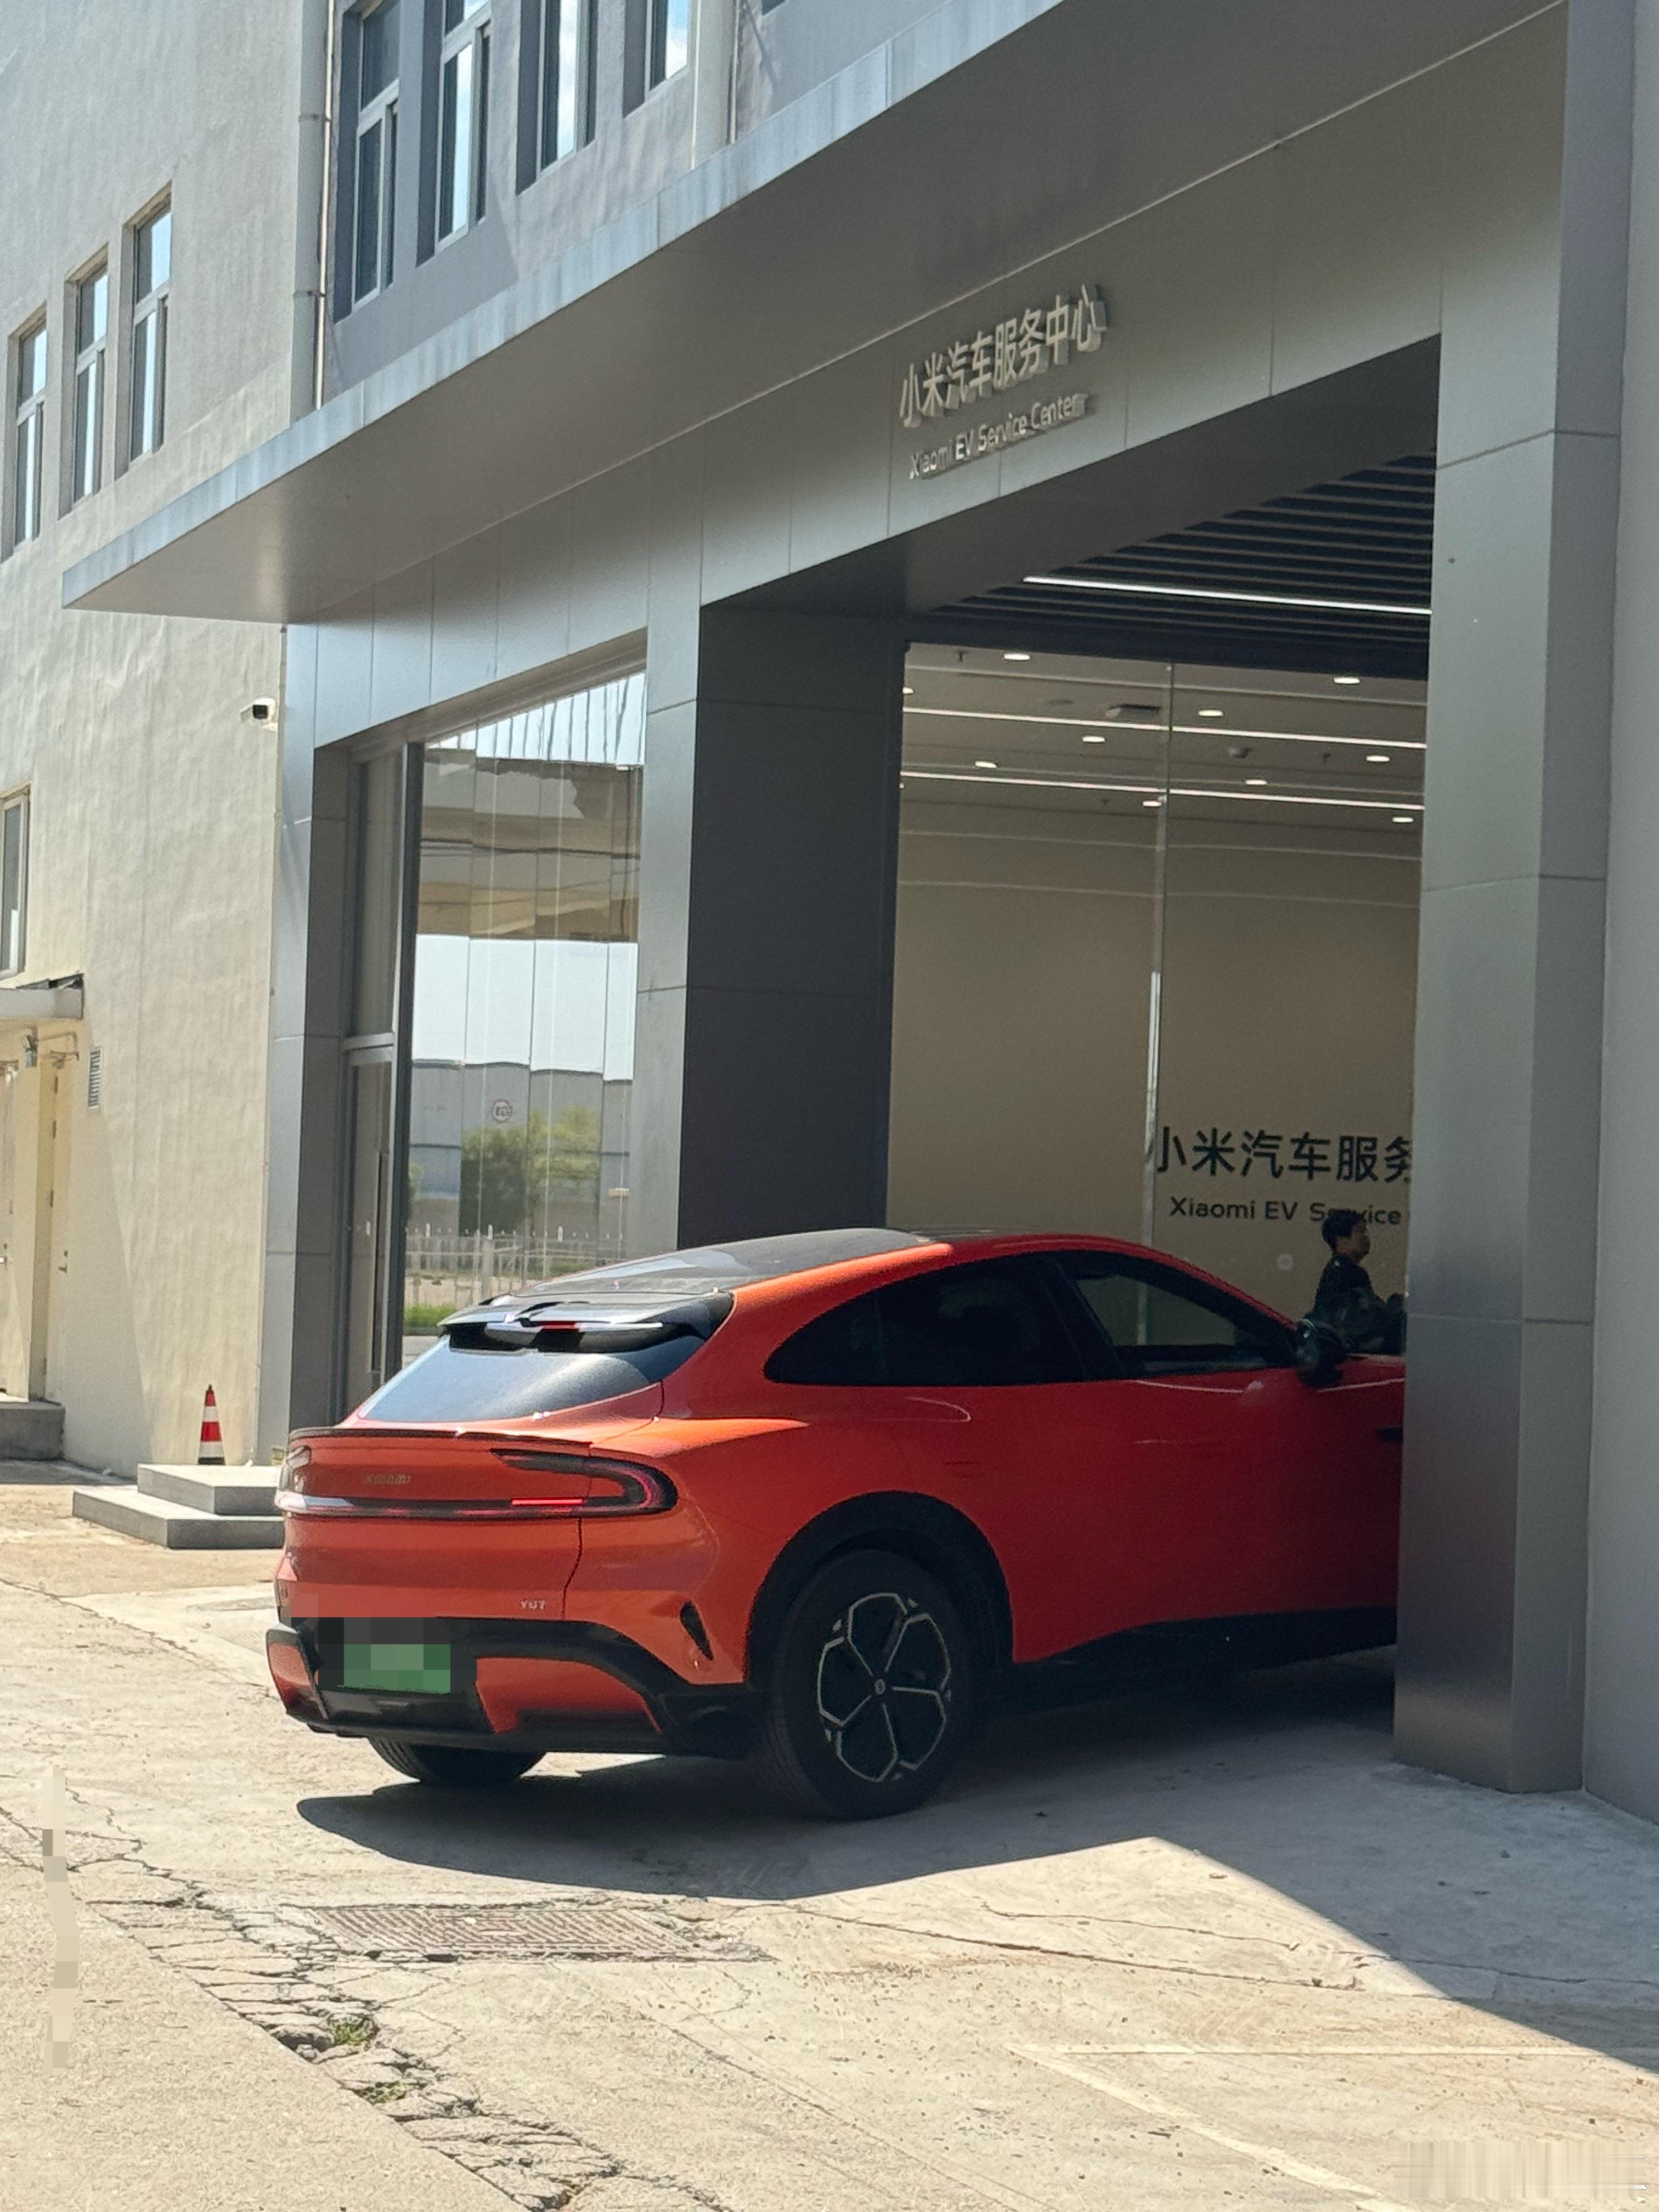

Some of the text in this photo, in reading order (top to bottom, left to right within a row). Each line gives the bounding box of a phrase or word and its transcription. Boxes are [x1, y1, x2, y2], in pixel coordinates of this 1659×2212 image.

[900, 284, 1107, 428] 小米汽车服务中心
[955, 429, 974, 461] EV
[978, 413, 1028, 452] Service
[1031, 393, 1089, 430] Center
[1156, 1126, 1412, 1182] 小米汽车服务
[1170, 1197, 1255, 1220] Xiaomi
[1265, 1200, 1298, 1220] EV
[521, 1600, 545, 1610] YU7
